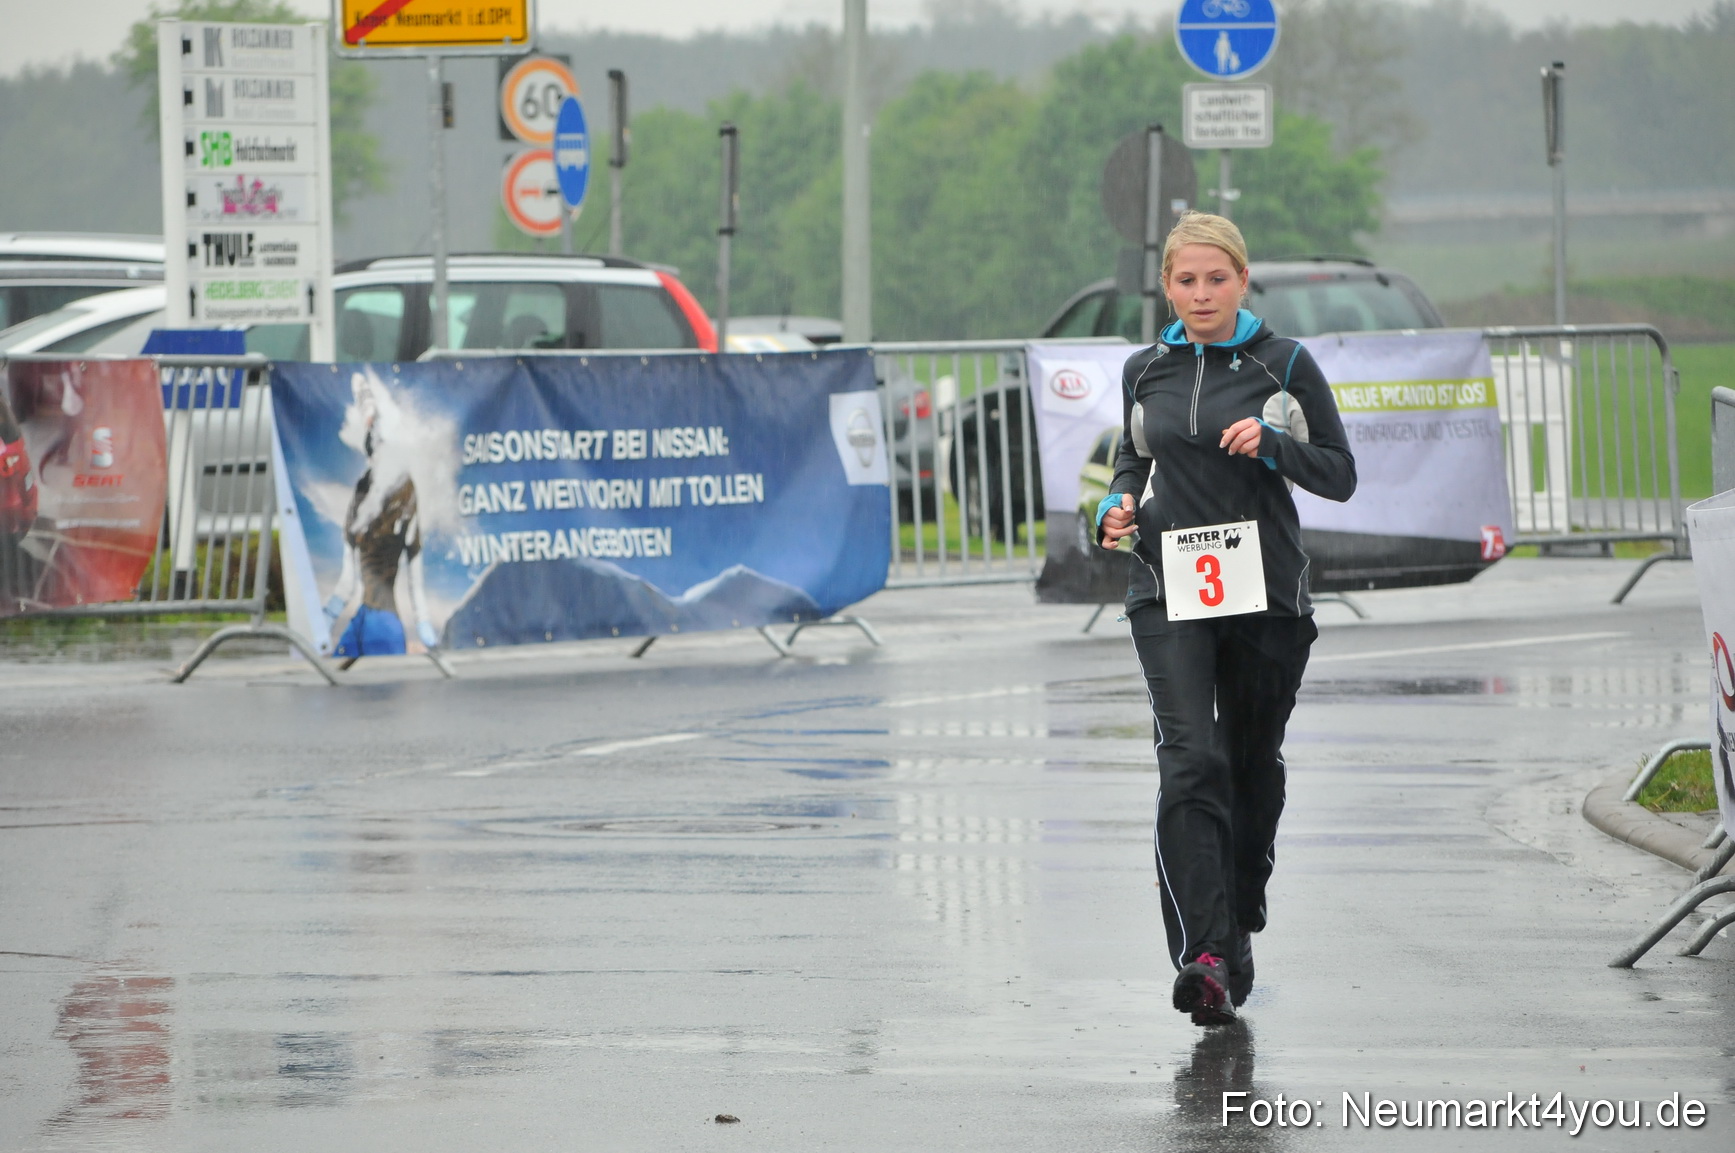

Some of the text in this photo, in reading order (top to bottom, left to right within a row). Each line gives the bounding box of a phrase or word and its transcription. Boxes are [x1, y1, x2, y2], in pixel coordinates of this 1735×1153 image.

[394, 10, 461, 27] Neumarkt
[521, 83, 561, 119] 60
[1340, 386, 1380, 408] NEUE
[1381, 383, 1436, 407] PICANTO
[1436, 383, 1455, 405] IST
[462, 426, 730, 464] SAISONSTART BEI NISSAN:
[73, 474, 124, 488] SEAT
[458, 481, 528, 515] GANZ
[530, 479, 584, 510] WEIT
[648, 477, 684, 507] MIT
[686, 473, 764, 506] TOLLEN
[456, 527, 672, 566] WINTERANGEBOTEN
[1177, 530, 1220, 545] MEYER
[1177, 540, 1222, 553] WERBUNG
[1195, 554, 1225, 608] 3
